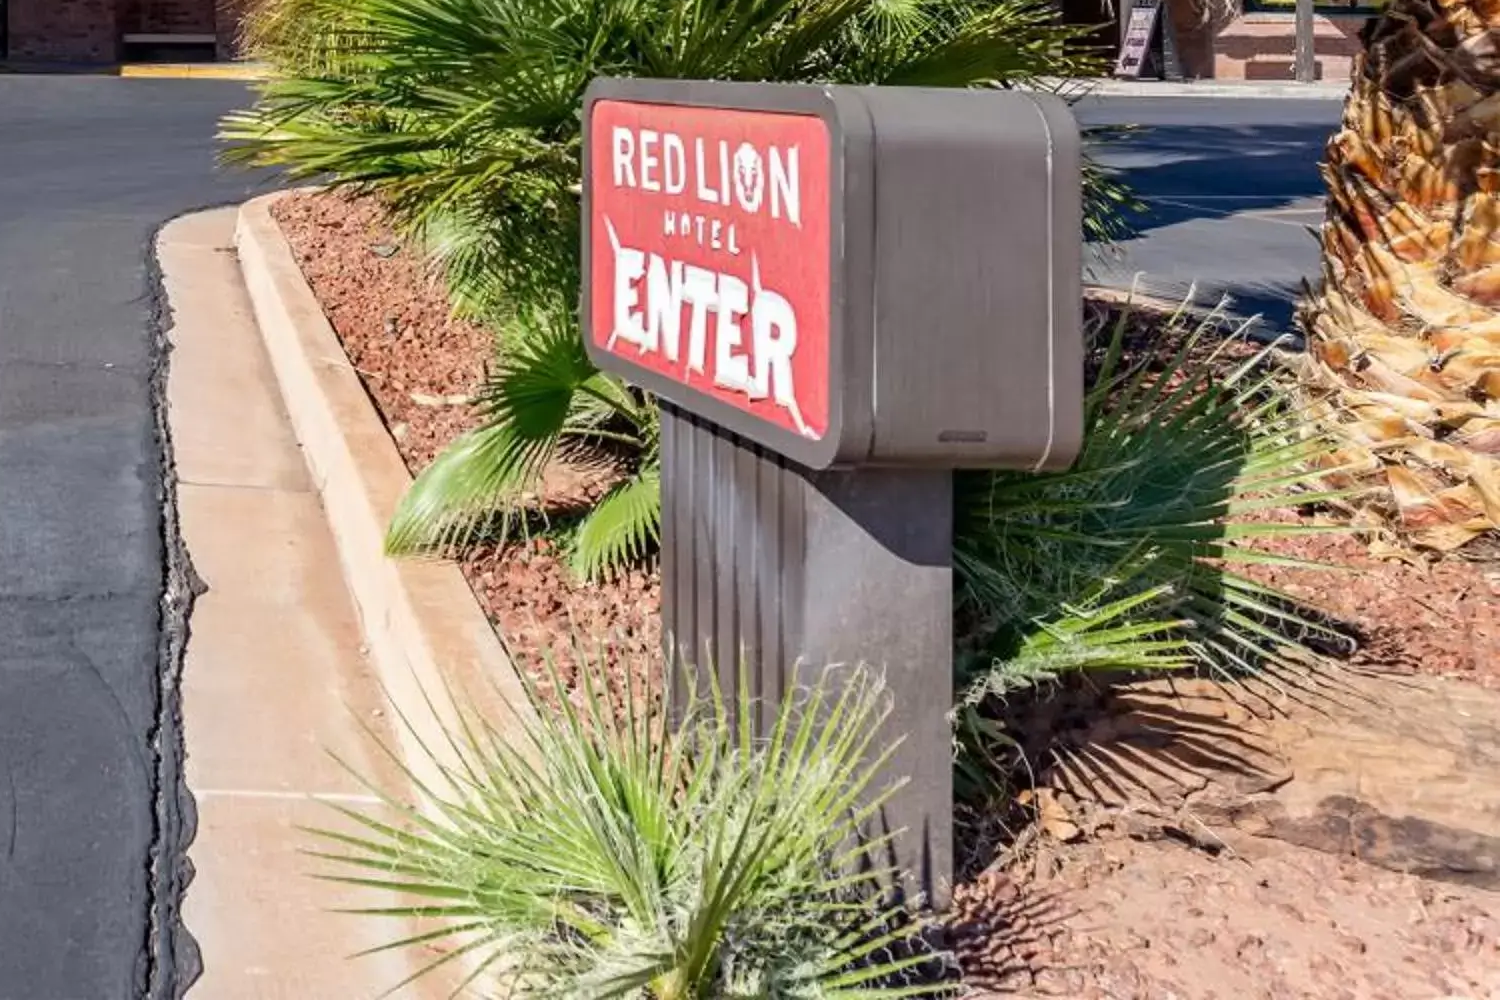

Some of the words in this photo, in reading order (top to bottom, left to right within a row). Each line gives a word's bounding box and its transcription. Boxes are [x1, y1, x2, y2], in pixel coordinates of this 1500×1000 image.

[612, 125, 687, 195] RED
[695, 136, 801, 230] LION
[663, 209, 741, 255] HOTEL
[608, 245, 801, 408] ENTER
